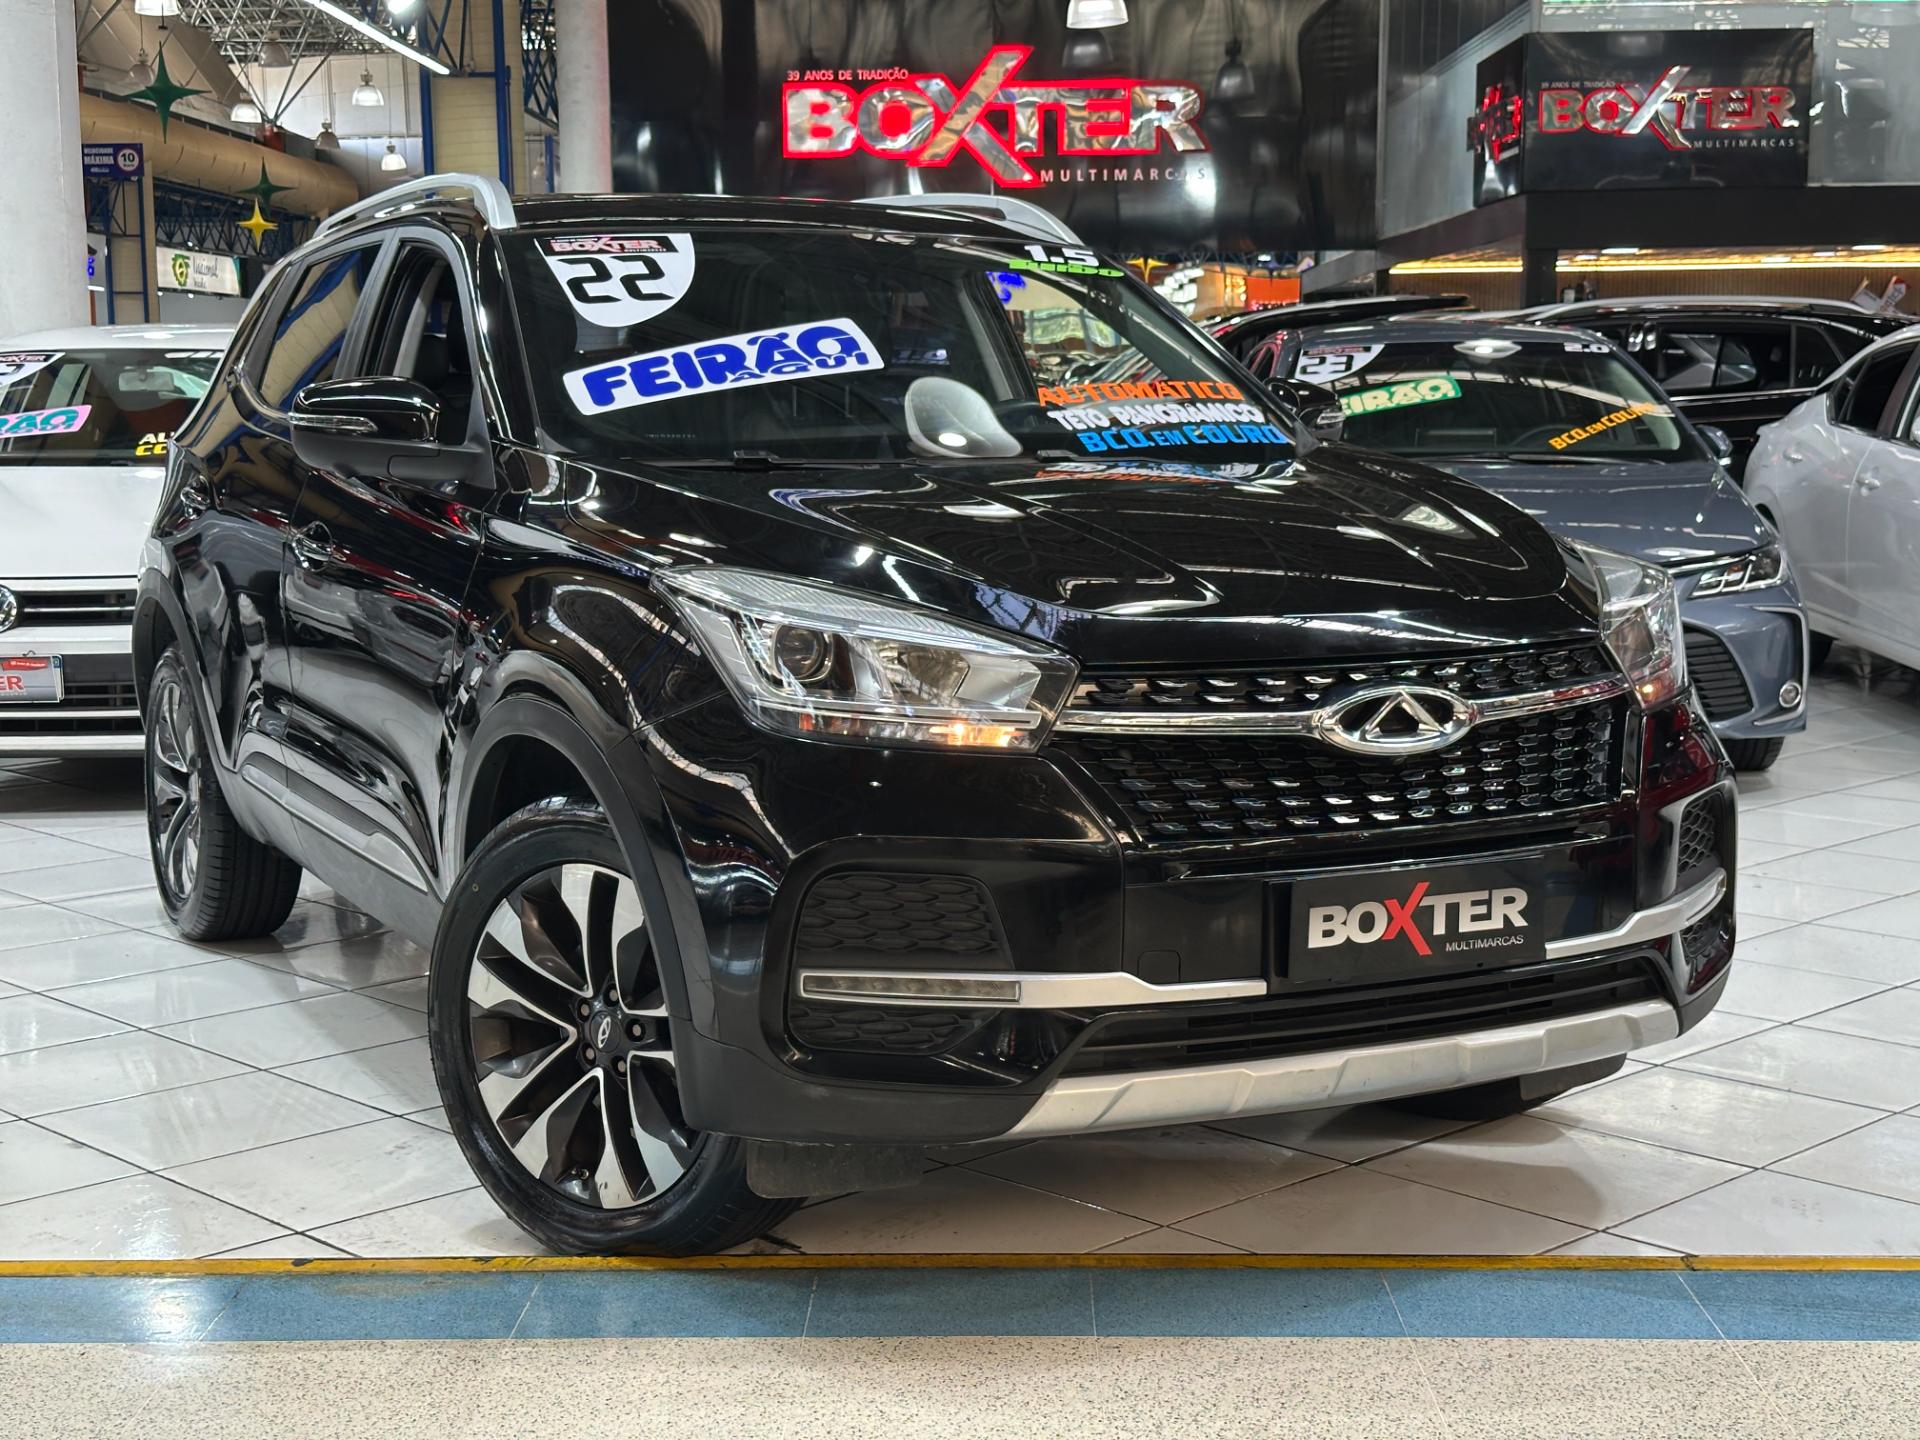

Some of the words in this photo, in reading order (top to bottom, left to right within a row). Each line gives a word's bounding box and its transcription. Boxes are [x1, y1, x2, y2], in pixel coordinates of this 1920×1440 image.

[787, 70, 800, 81] 39
[804, 70, 834, 81] ANOS
[838, 70, 853, 81] DE
[857, 67, 909, 81] TRADIÇÃO
[784, 45, 1209, 187] BOXTER
[1539, 65, 1799, 151] BOXTER
[1694, 138, 1795, 149] MULTIMARCAS
[121, 152, 136, 163] 10
[550, 237, 662, 253] BOXTER
[1024, 245, 1100, 267] 1.5
[556, 255, 675, 304] 22
[582, 325, 862, 407] FEIRÃO
[729, 352, 869, 382] AQUI
[1299, 354, 1355, 376] 23
[1047, 407, 1111, 431] TETO
[1308, 881, 1529, 956] BOXTER
[1445, 934, 1524, 952] MULTIMARCAS
